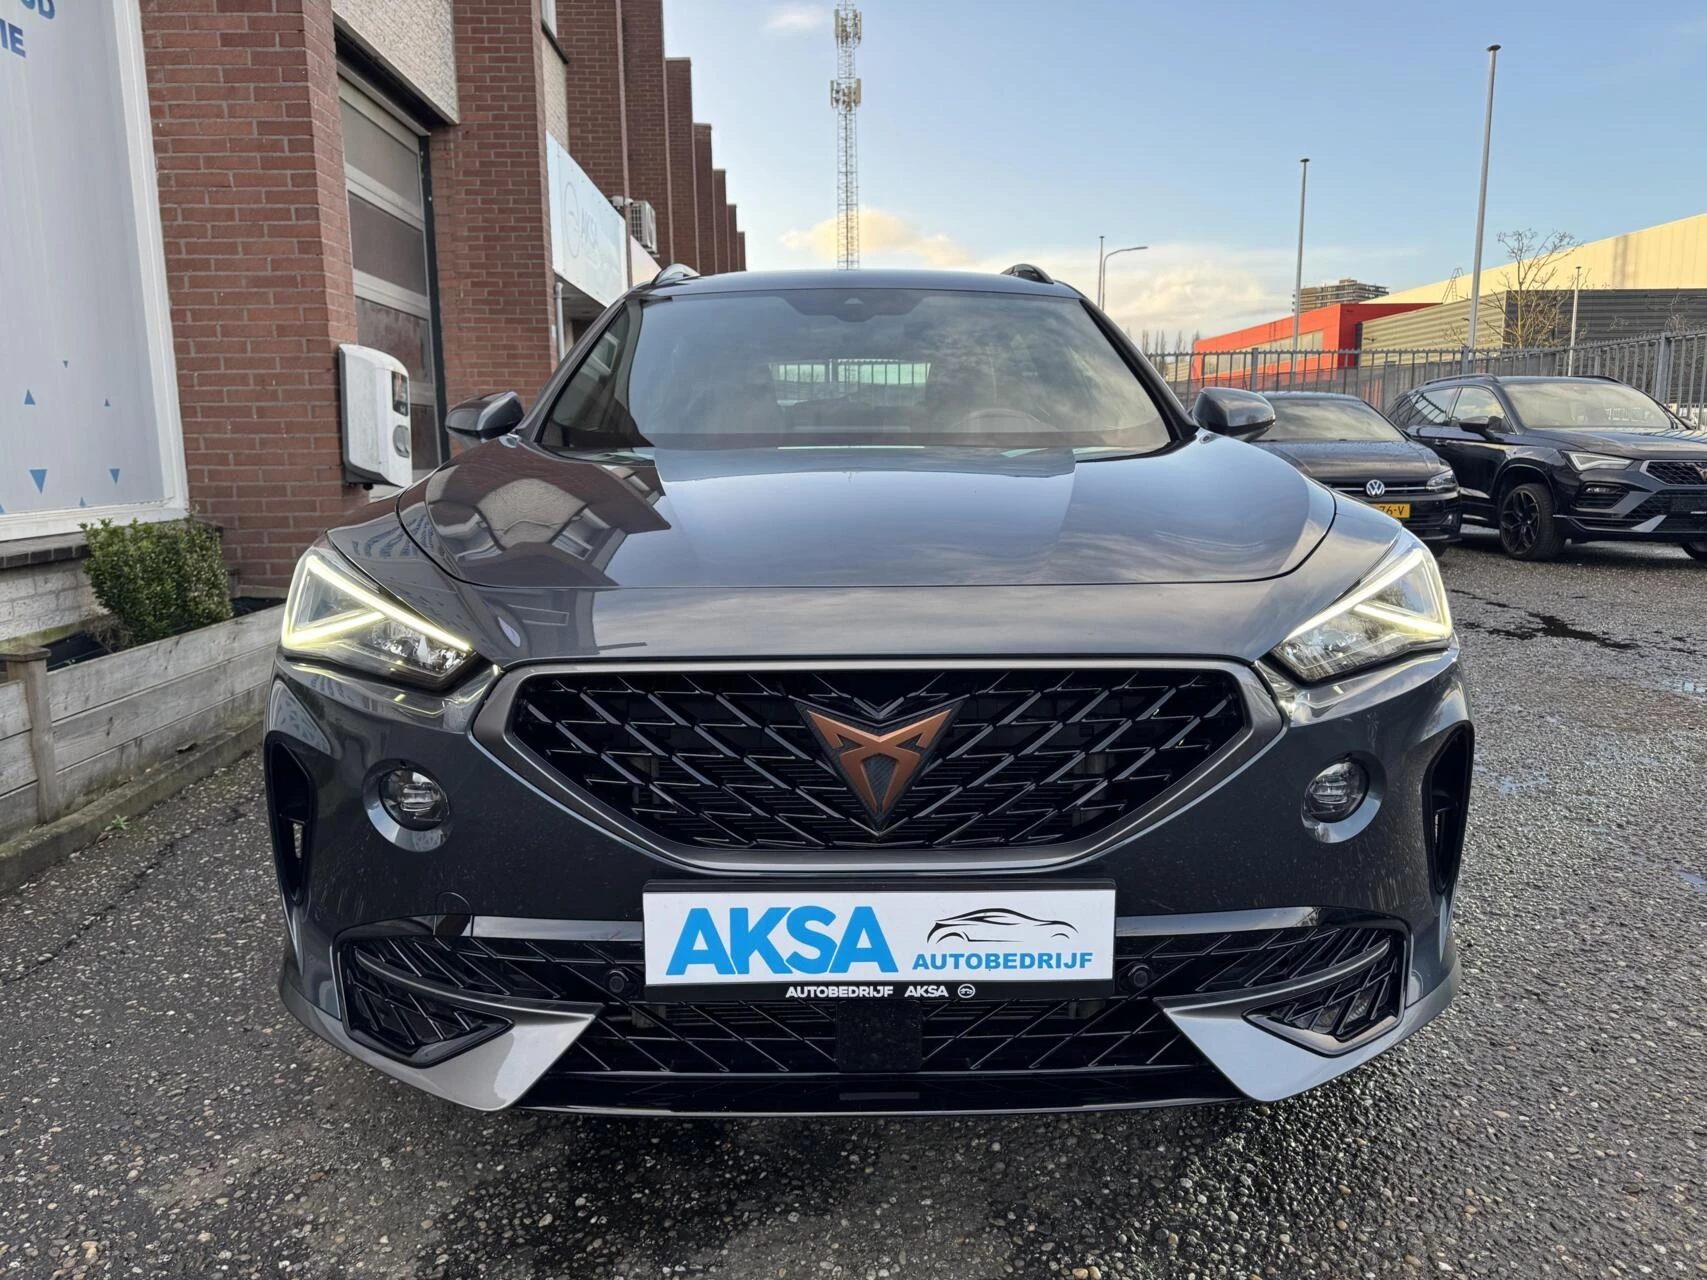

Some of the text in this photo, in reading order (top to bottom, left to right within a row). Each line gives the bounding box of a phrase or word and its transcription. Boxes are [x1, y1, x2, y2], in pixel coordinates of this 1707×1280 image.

[666, 905, 898, 976] AKSA
[912, 952, 1093, 970] AUTOBEDRIJF
[785, 985, 949, 998] AUTOBEDRIJF AKSA
